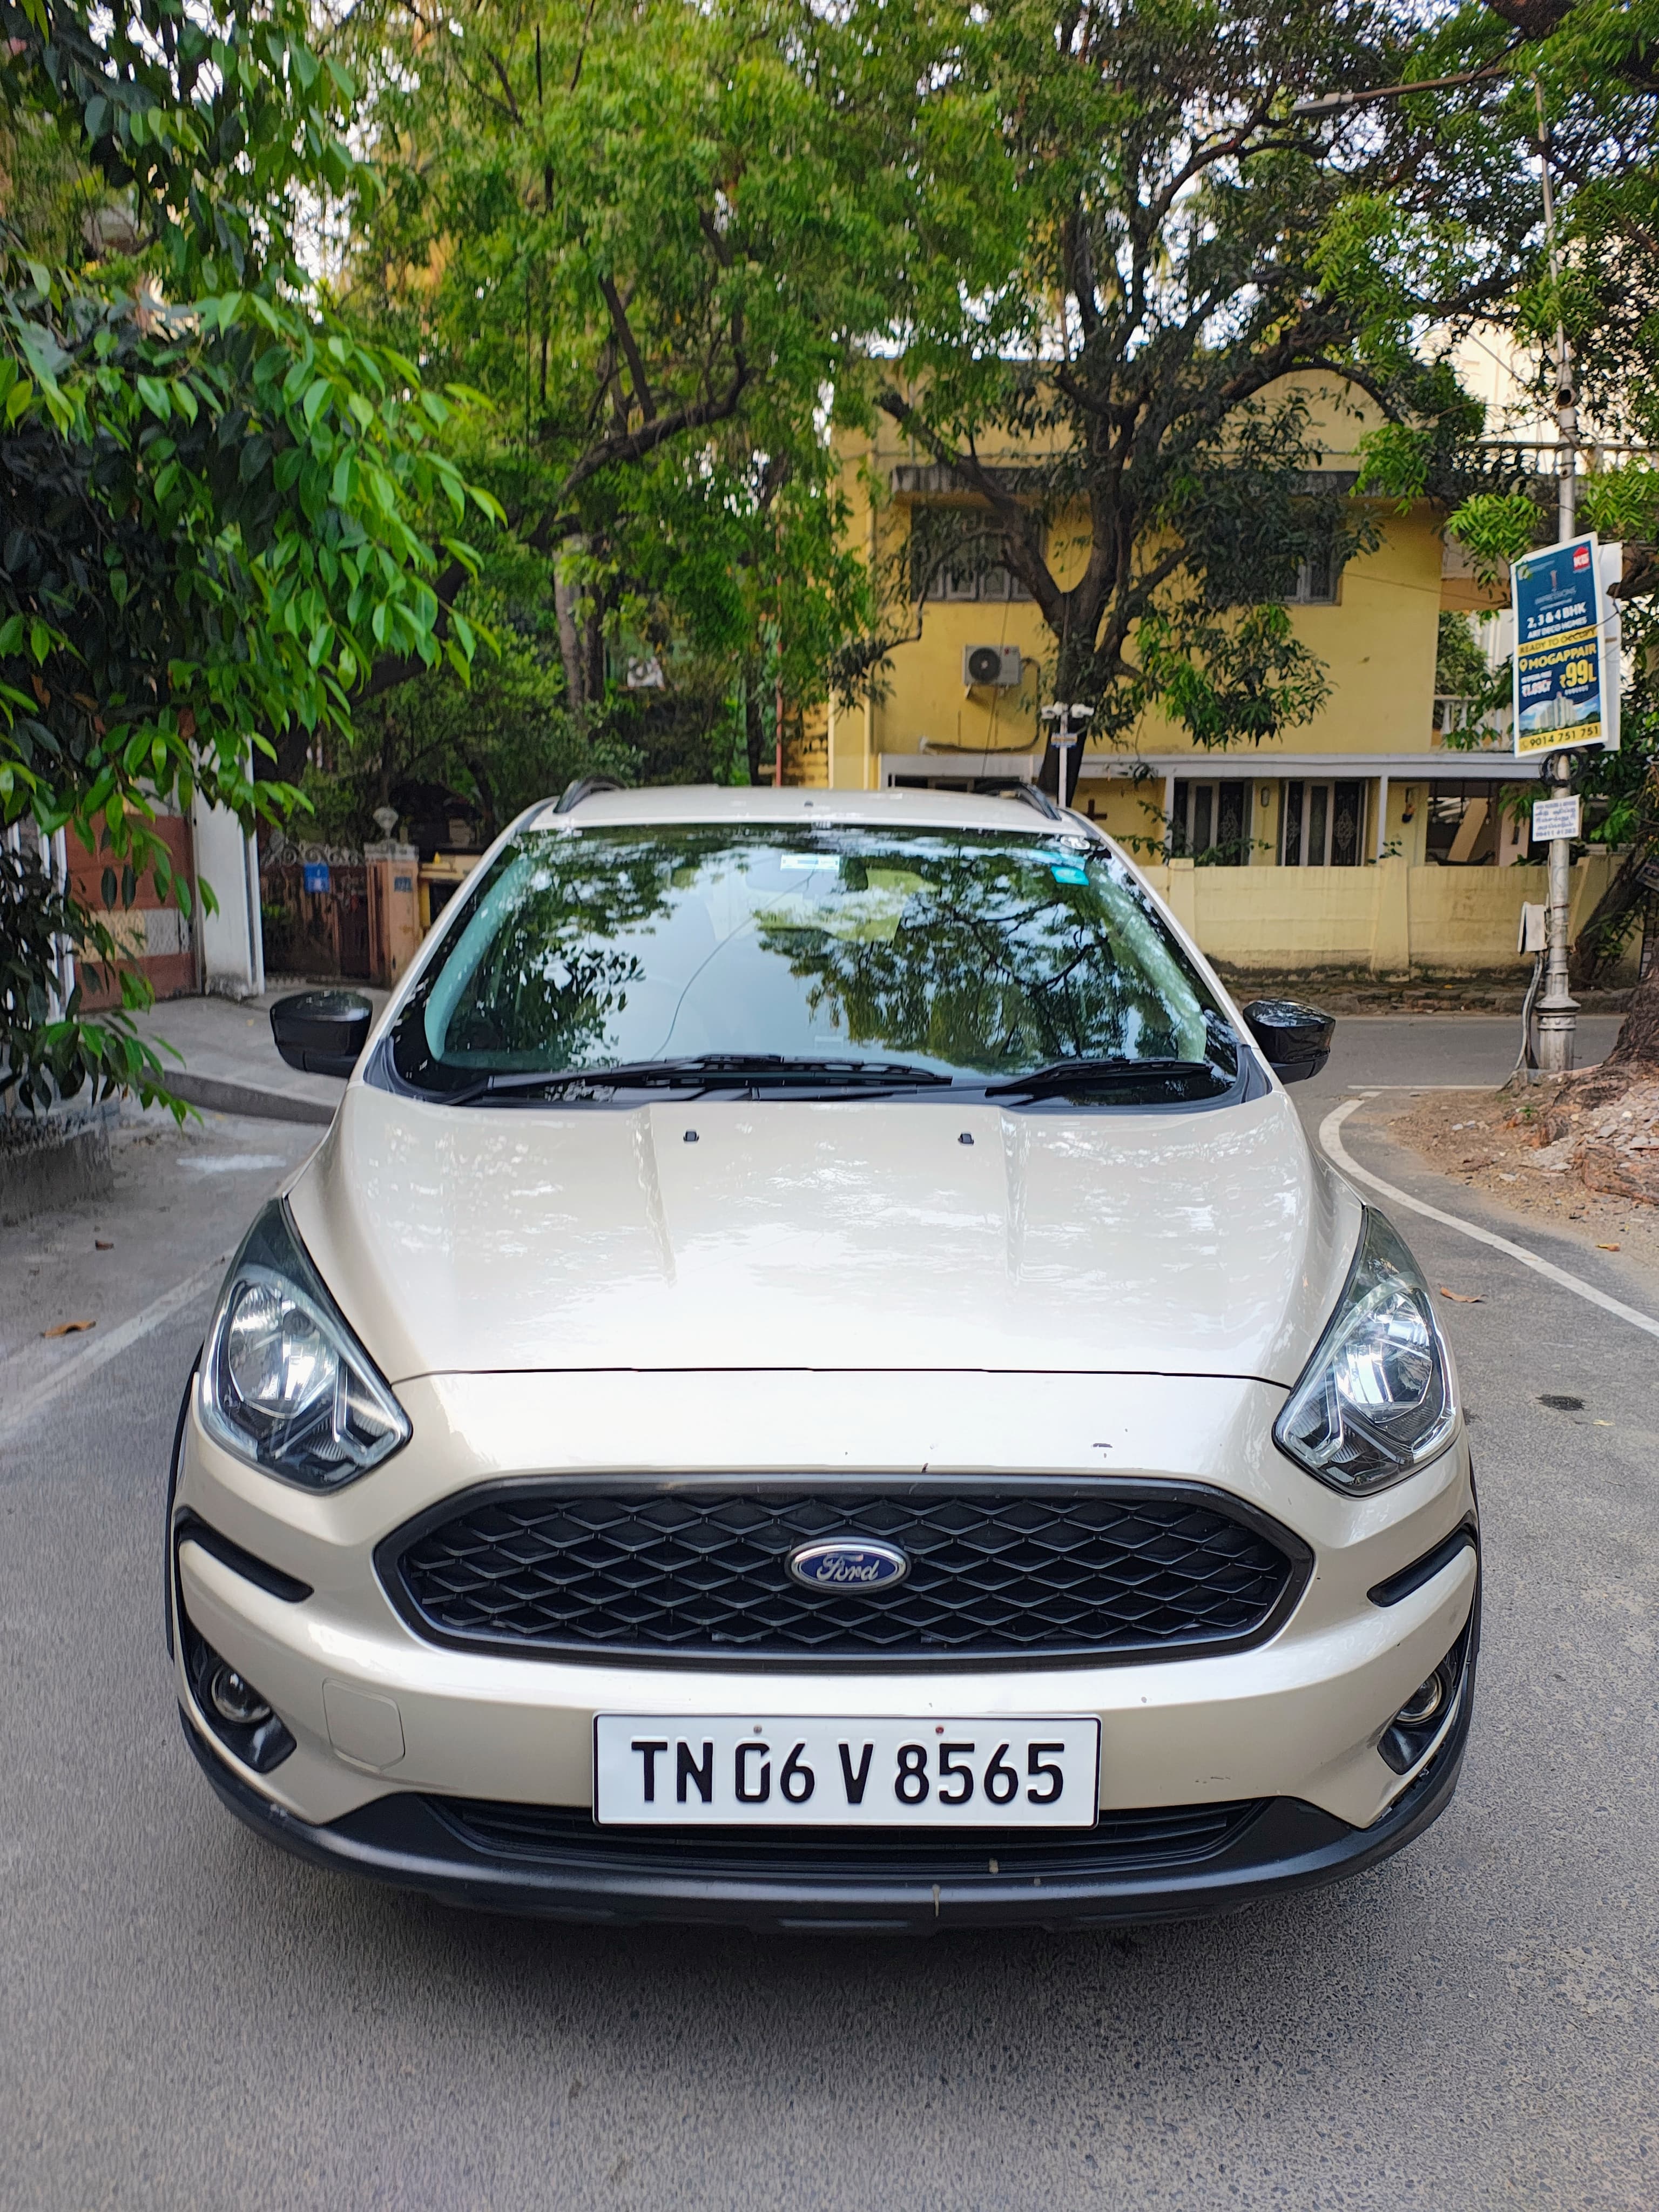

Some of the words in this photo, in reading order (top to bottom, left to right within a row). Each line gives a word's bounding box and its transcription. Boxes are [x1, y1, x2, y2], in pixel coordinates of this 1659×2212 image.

[1562, 602, 1587, 619] BHK
[1519, 640, 1546, 654] READY
[1548, 637, 1559, 647] TO
[1560, 628, 1596, 644] OCCUPY
[1528, 643, 1596, 671] MOGAPPAIR
[1529, 734, 1555, 747] 9014
[1558, 730, 1576, 743] 751
[1580, 725, 1599, 737] 751
[816, 1552, 880, 1581] Ford
[631, 1741, 713, 1803] TN
[735, 1743, 815, 1804] 06
[838, 1743, 874, 1804] V
[894, 1743, 1065, 1805] 8565
